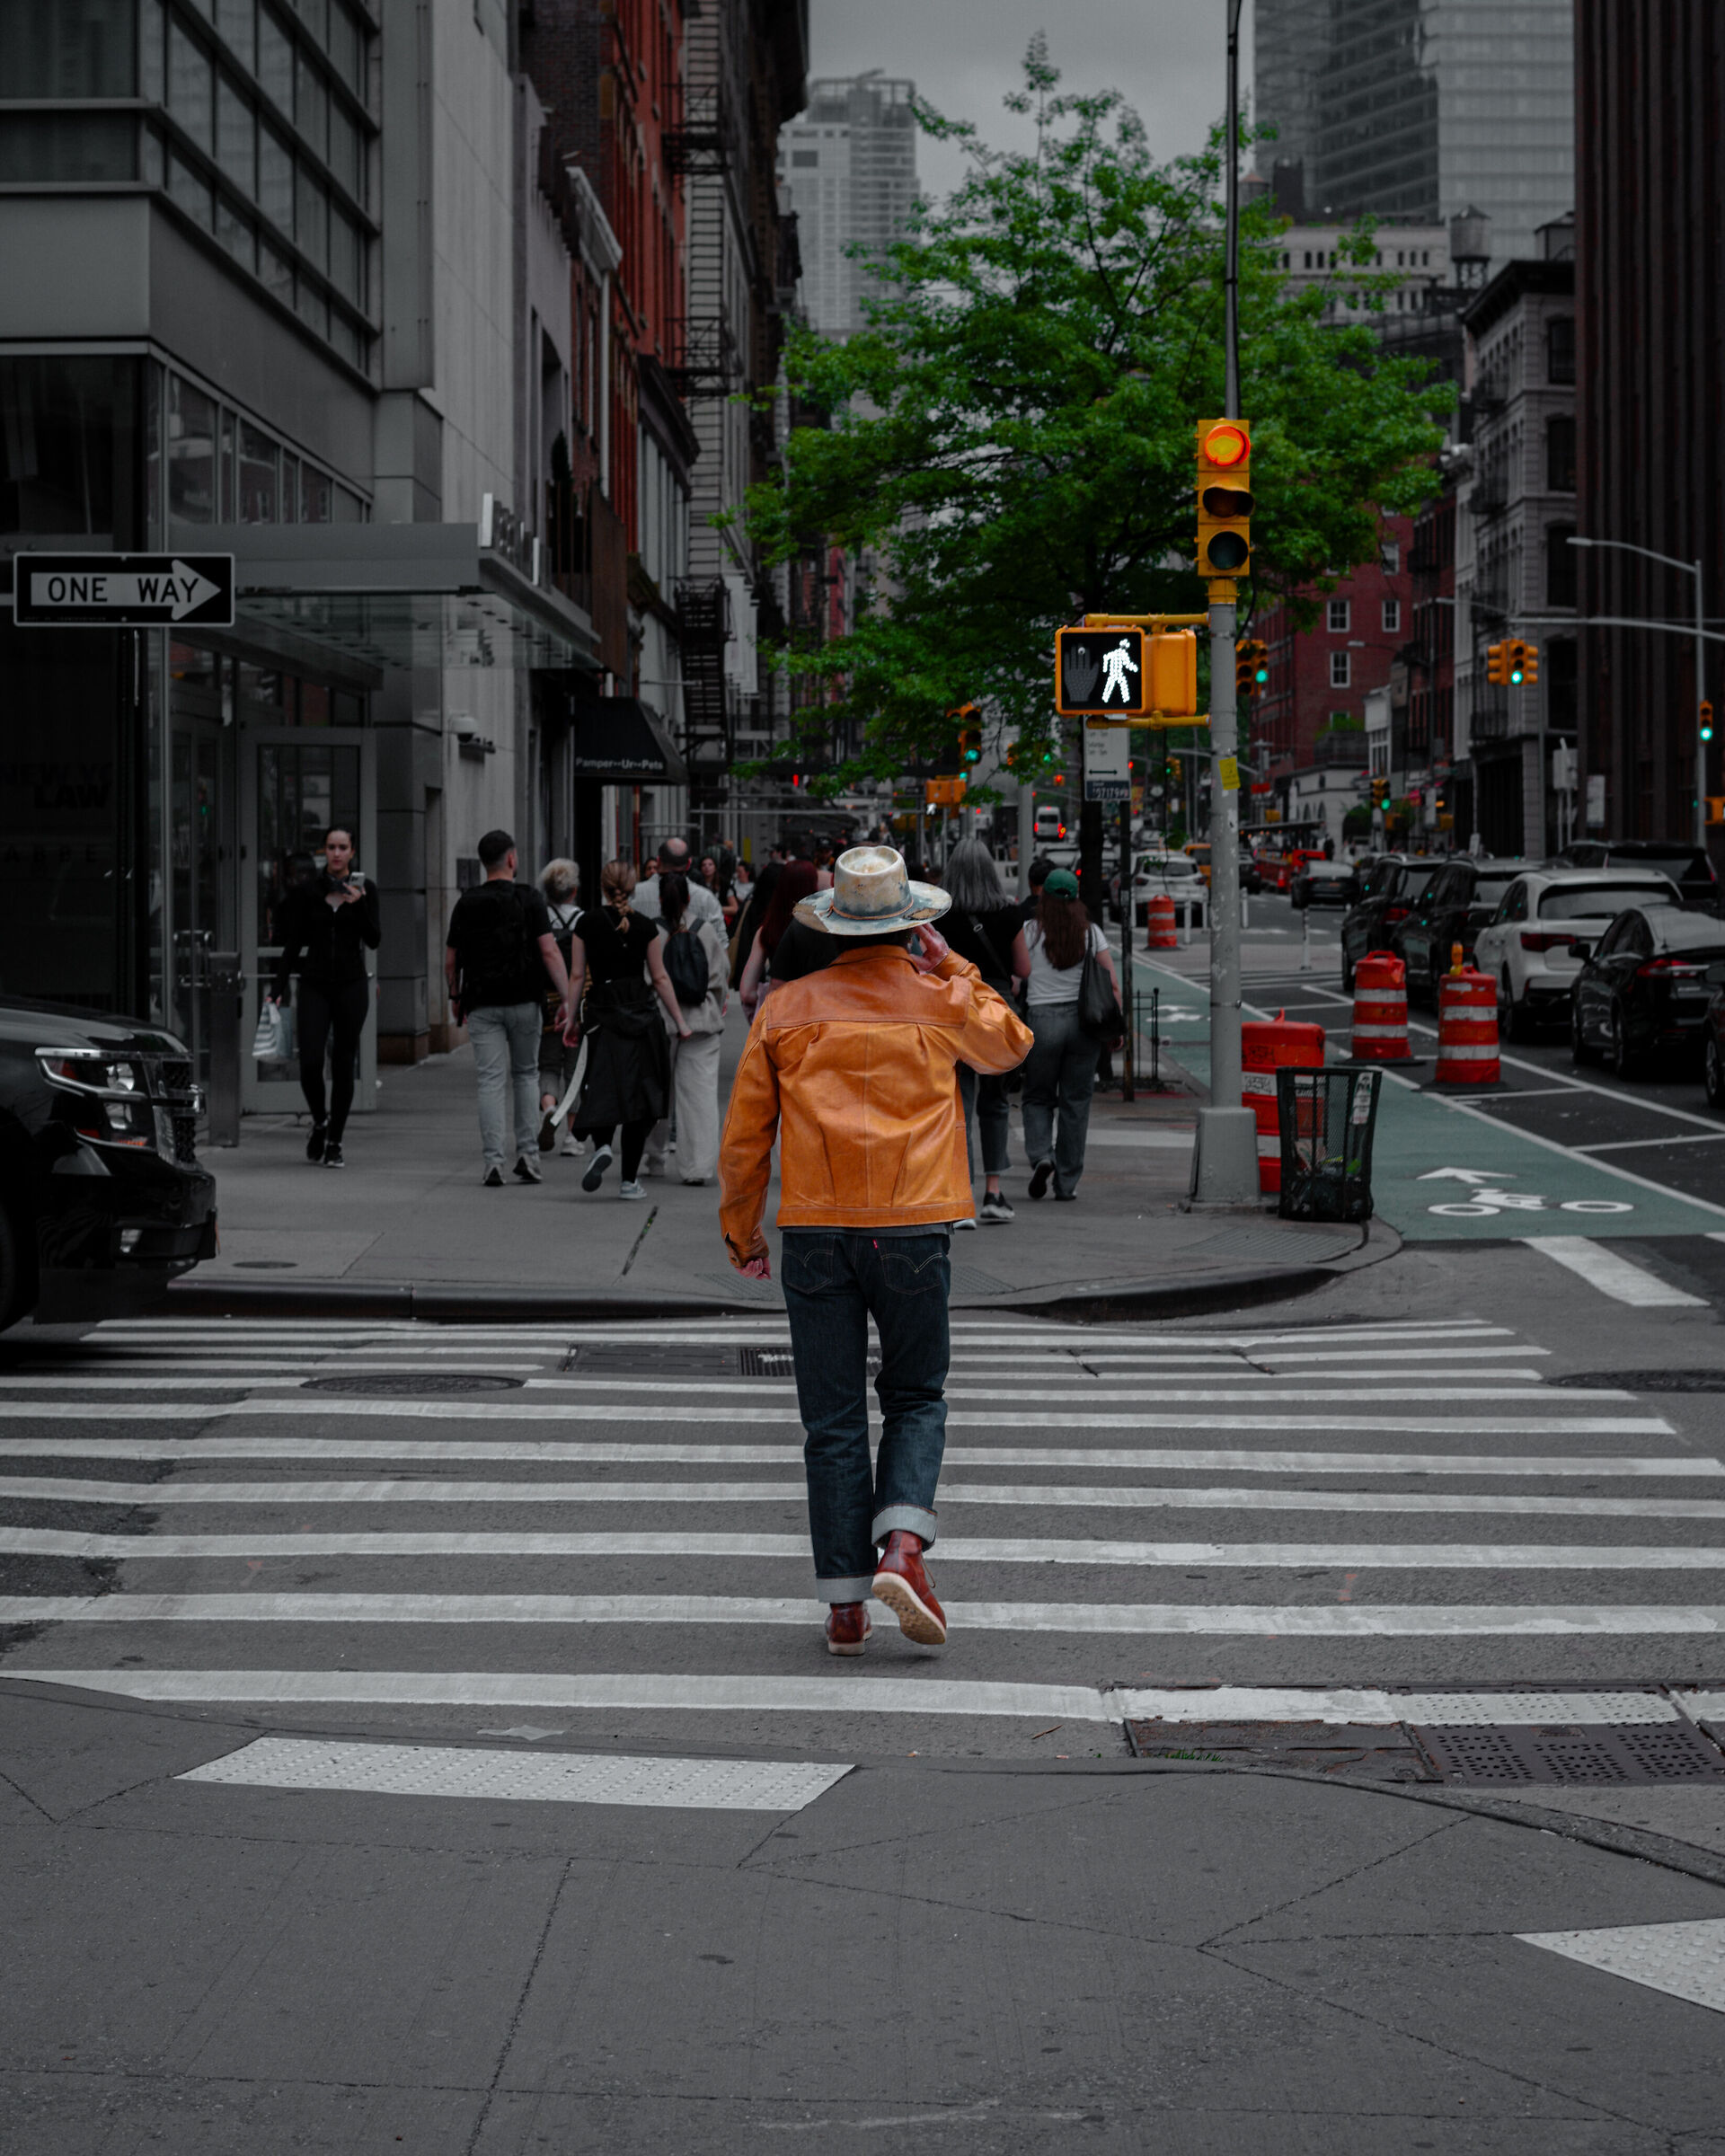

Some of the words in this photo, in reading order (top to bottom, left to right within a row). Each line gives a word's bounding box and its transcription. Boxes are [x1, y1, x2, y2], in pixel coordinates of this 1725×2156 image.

[48, 576, 108, 603] ONE
[137, 577, 199, 604] WAY
[34, 783, 109, 809] LAW
